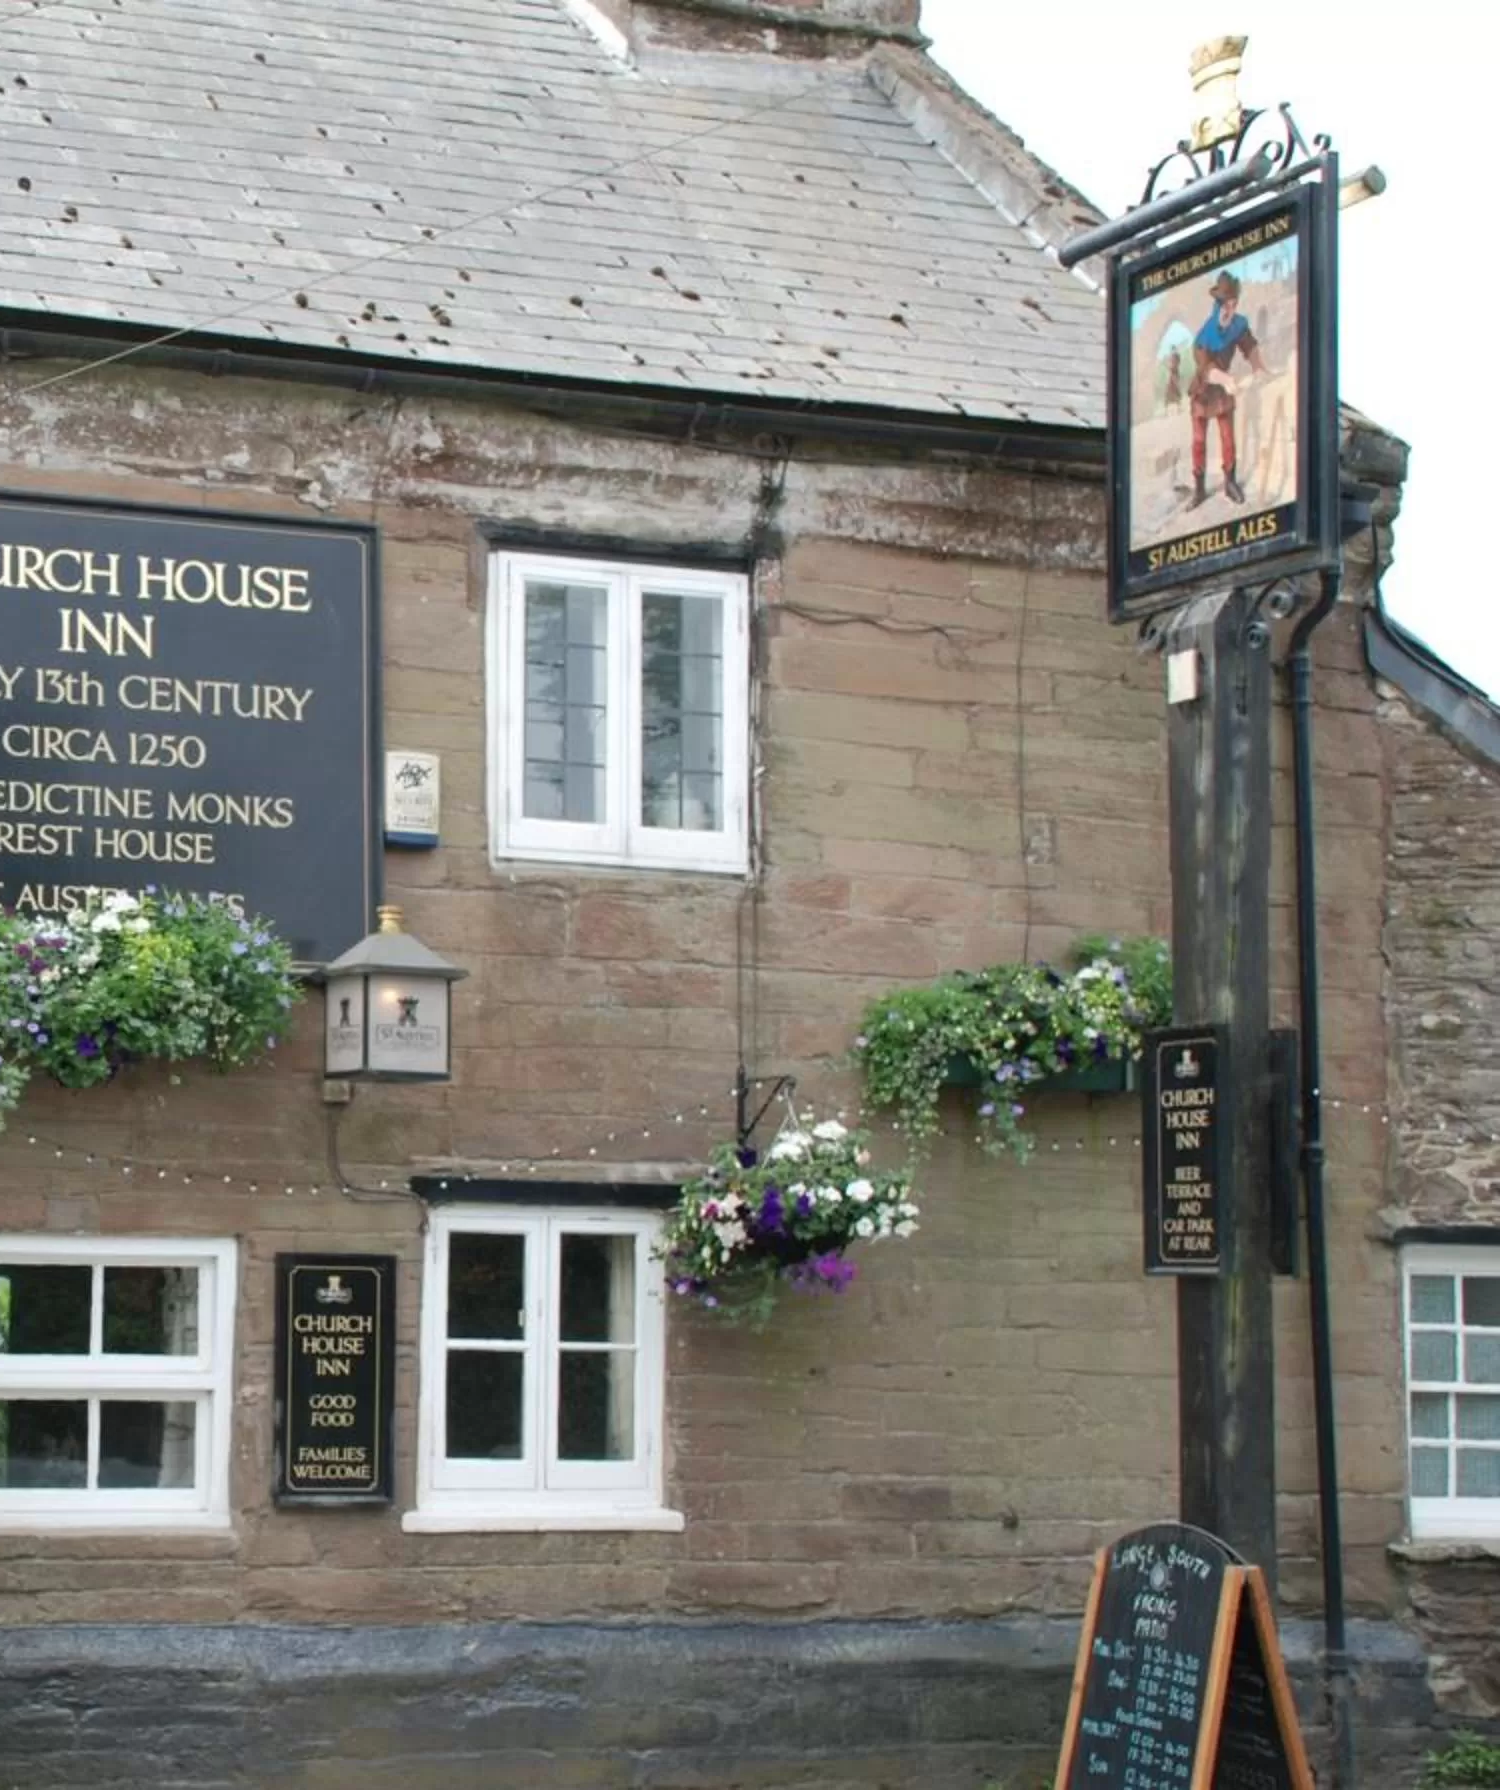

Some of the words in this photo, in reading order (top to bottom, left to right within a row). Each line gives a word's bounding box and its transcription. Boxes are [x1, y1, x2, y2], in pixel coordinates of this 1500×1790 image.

[1142, 269, 1166, 291] THE
[1166, 246, 1219, 281] CHURCH
[1219, 227, 1263, 259] HOUSE
[1265, 214, 1292, 239] INN
[1167, 527, 1233, 564] AUSTELL
[1236, 512, 1277, 544] ALES
[137, 557, 312, 613] HOUSE
[58, 608, 156, 659] INN
[35, 668, 105, 707] 13th
[118, 675, 314, 721] CENTURY
[2, 724, 117, 765] CIRCA
[128, 732, 207, 769] 1250
[166, 791, 294, 829] MONKS
[95, 828, 215, 864] HOUSE
[1161, 1087, 1214, 1108] CHURCH
[1166, 1109, 1211, 1129] HOUSE
[1175, 1132, 1200, 1150] INN
[1175, 1166, 1201, 1181] BEER
[1166, 1183, 1212, 1199] TERRACE
[1177, 1202, 1201, 1216] AND
[1163, 1218, 1185, 1233] CAR
[1187, 1217, 1214, 1233] PARK
[1168, 1236, 1182, 1251] AT
[1184, 1235, 1211, 1251] REAR
[294, 1314, 373, 1333] CHURCH
[302, 1336, 365, 1355] HOUSE
[316, 1359, 351, 1376] INN
[309, 1394, 357, 1409] GOOD
[311, 1412, 355, 1427] FOOD
[298, 1447, 366, 1462] FAMILIES
[293, 1464, 372, 1480] WELCOME
